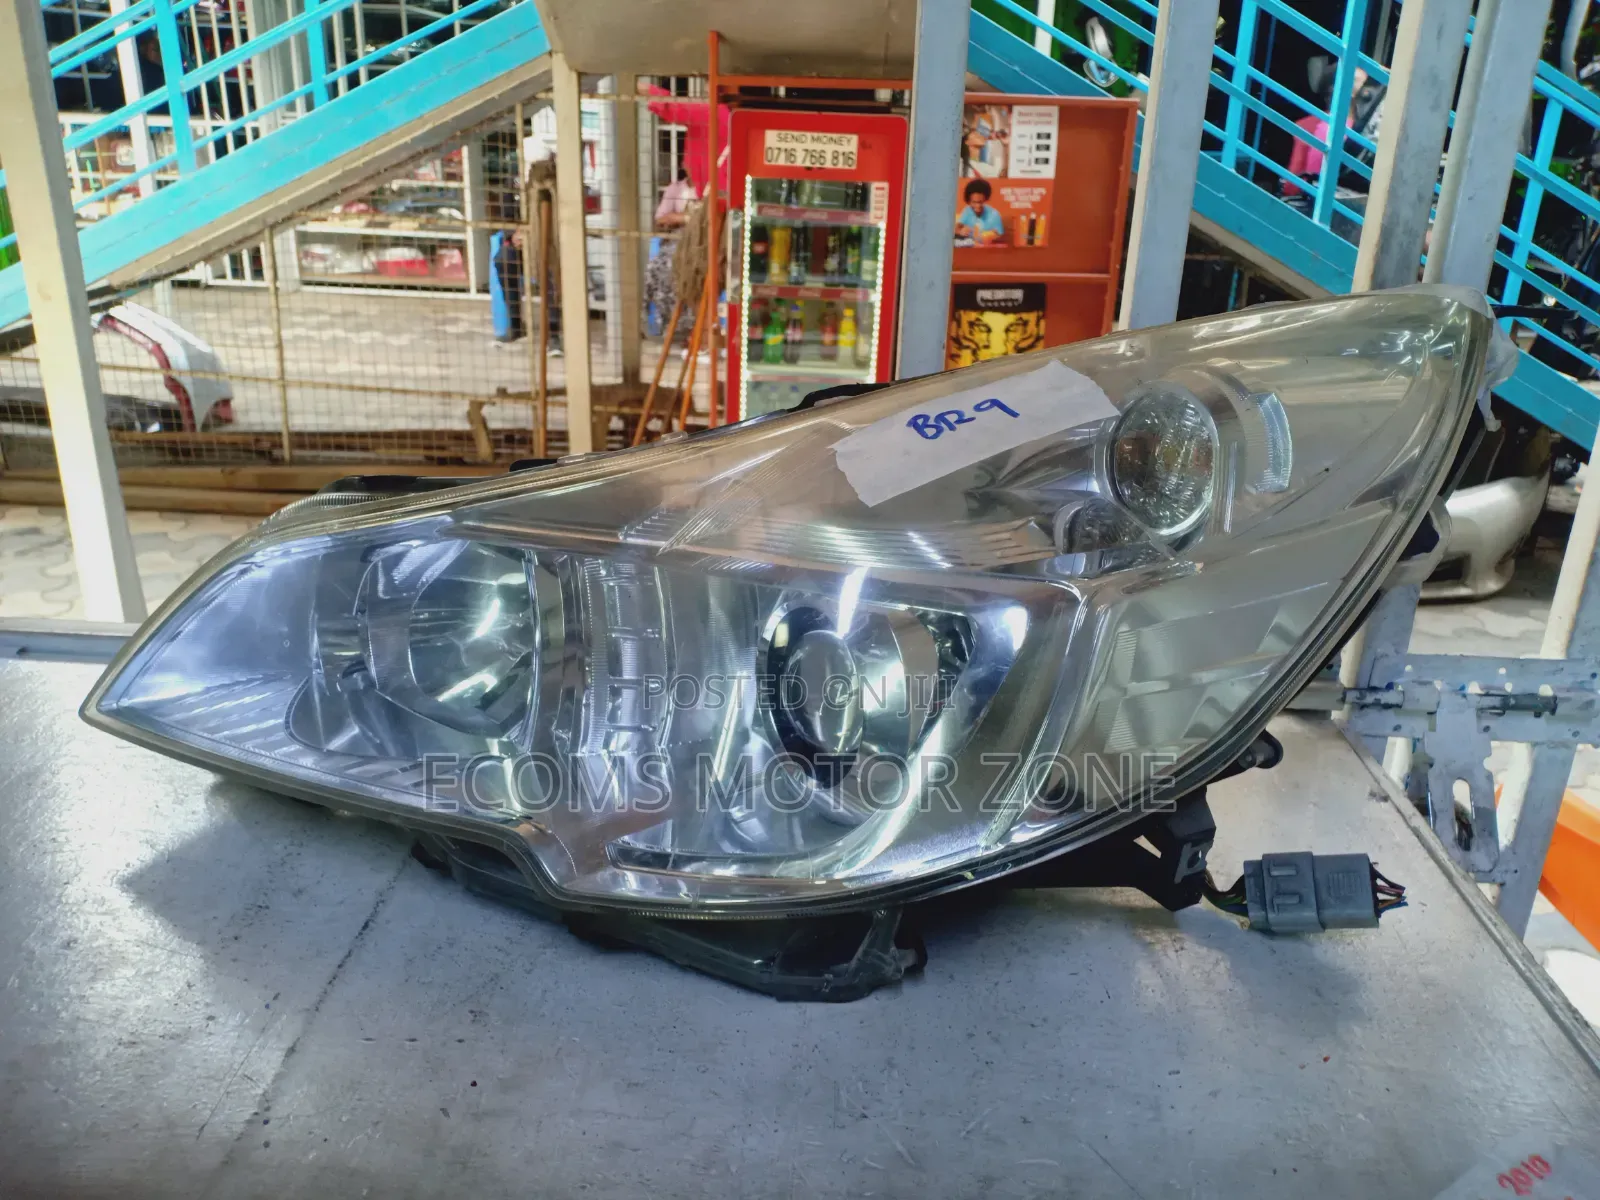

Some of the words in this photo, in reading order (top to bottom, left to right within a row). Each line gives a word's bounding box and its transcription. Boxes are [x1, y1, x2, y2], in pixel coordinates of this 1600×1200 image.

[776, 132, 807, 144] SEND
[811, 135, 852, 146] MONEY
[765, 147, 797, 164] 0716
[801, 149, 826, 166] 766
[831, 150, 856, 167] 816
[1496, 1153, 1552, 1196] 2010
